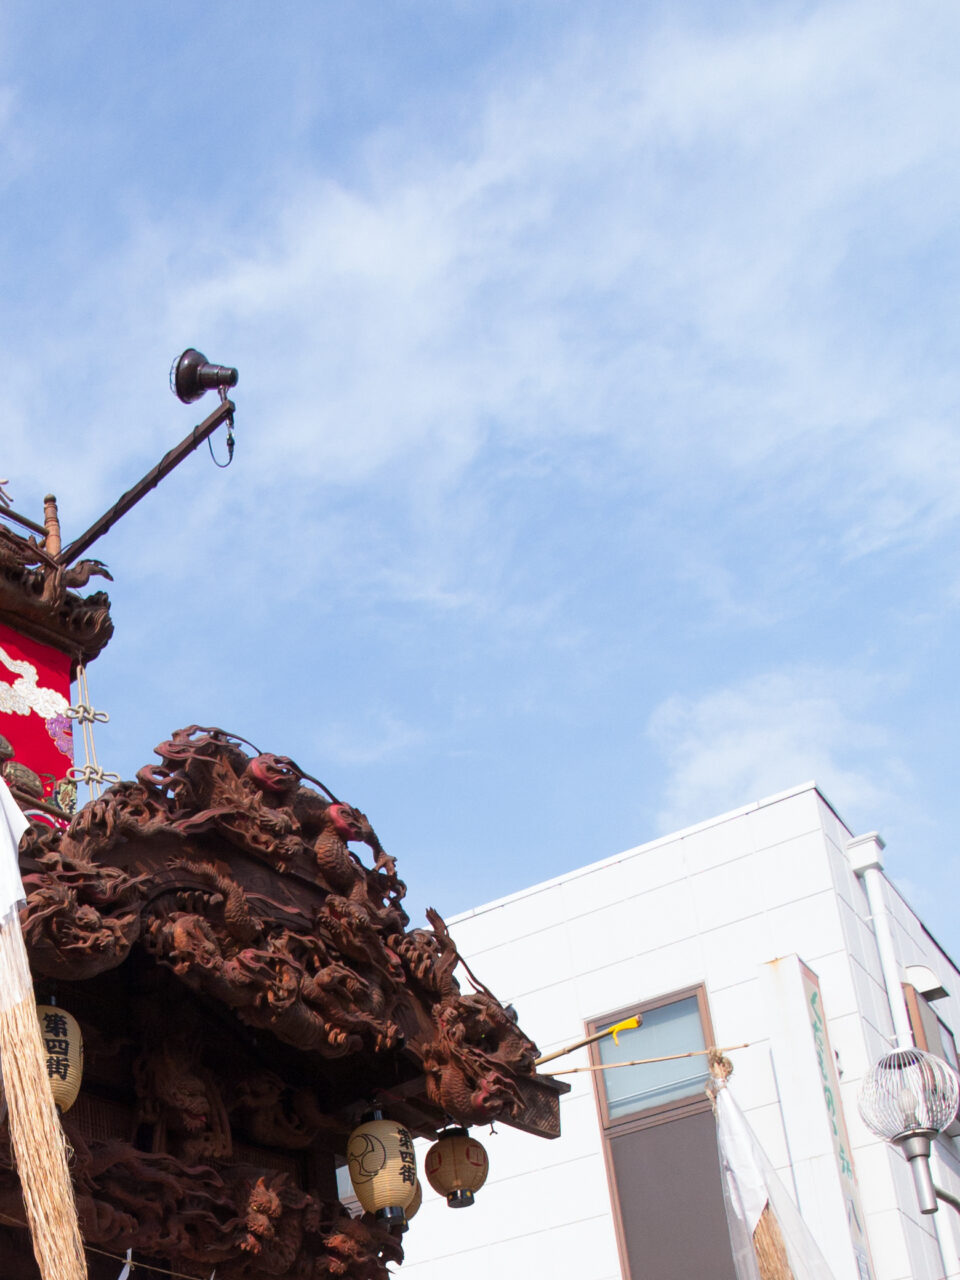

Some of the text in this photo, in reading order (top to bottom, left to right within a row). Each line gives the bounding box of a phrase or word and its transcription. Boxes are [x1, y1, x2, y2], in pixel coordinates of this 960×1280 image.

[43, 1012, 70, 1080] 第四街
[396, 1127, 416, 1186] 第四街
